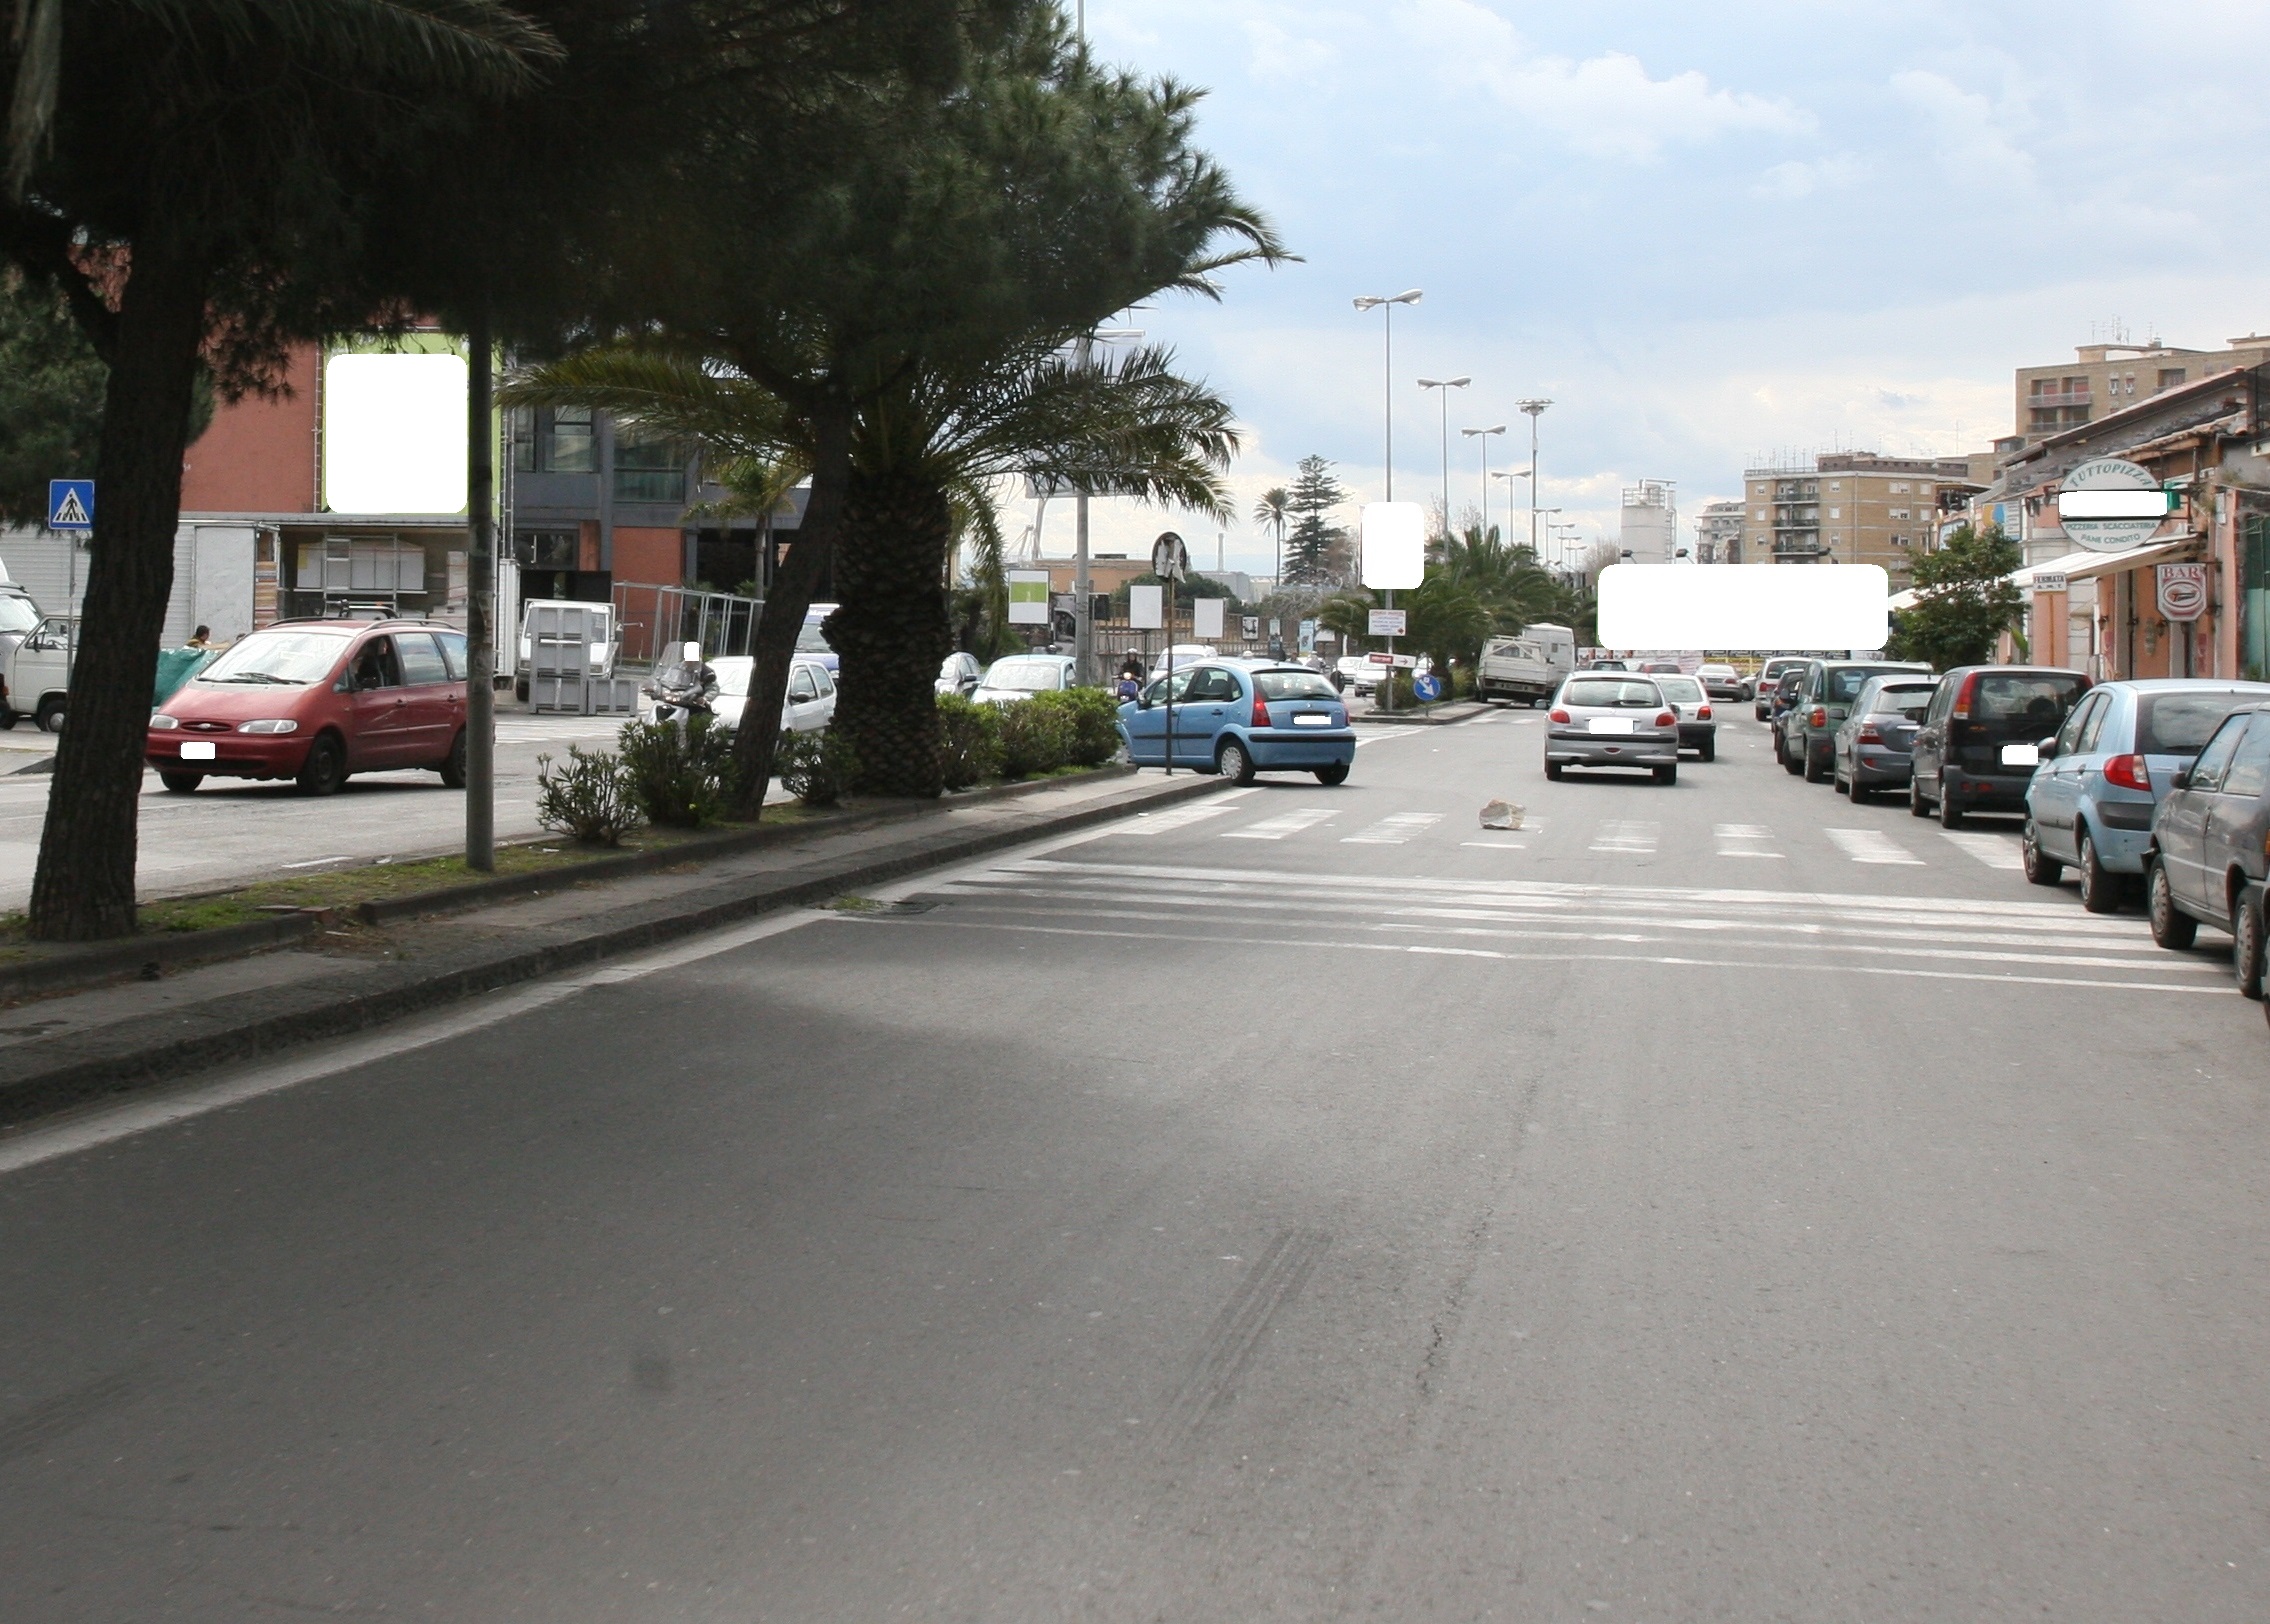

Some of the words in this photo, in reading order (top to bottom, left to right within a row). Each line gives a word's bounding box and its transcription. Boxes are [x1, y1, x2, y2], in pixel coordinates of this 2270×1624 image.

[2069, 464, 2152, 488] TUTTOPIZZA
[2103, 533, 2142, 544] CONDITO
[2163, 567, 2200, 578] BAR
